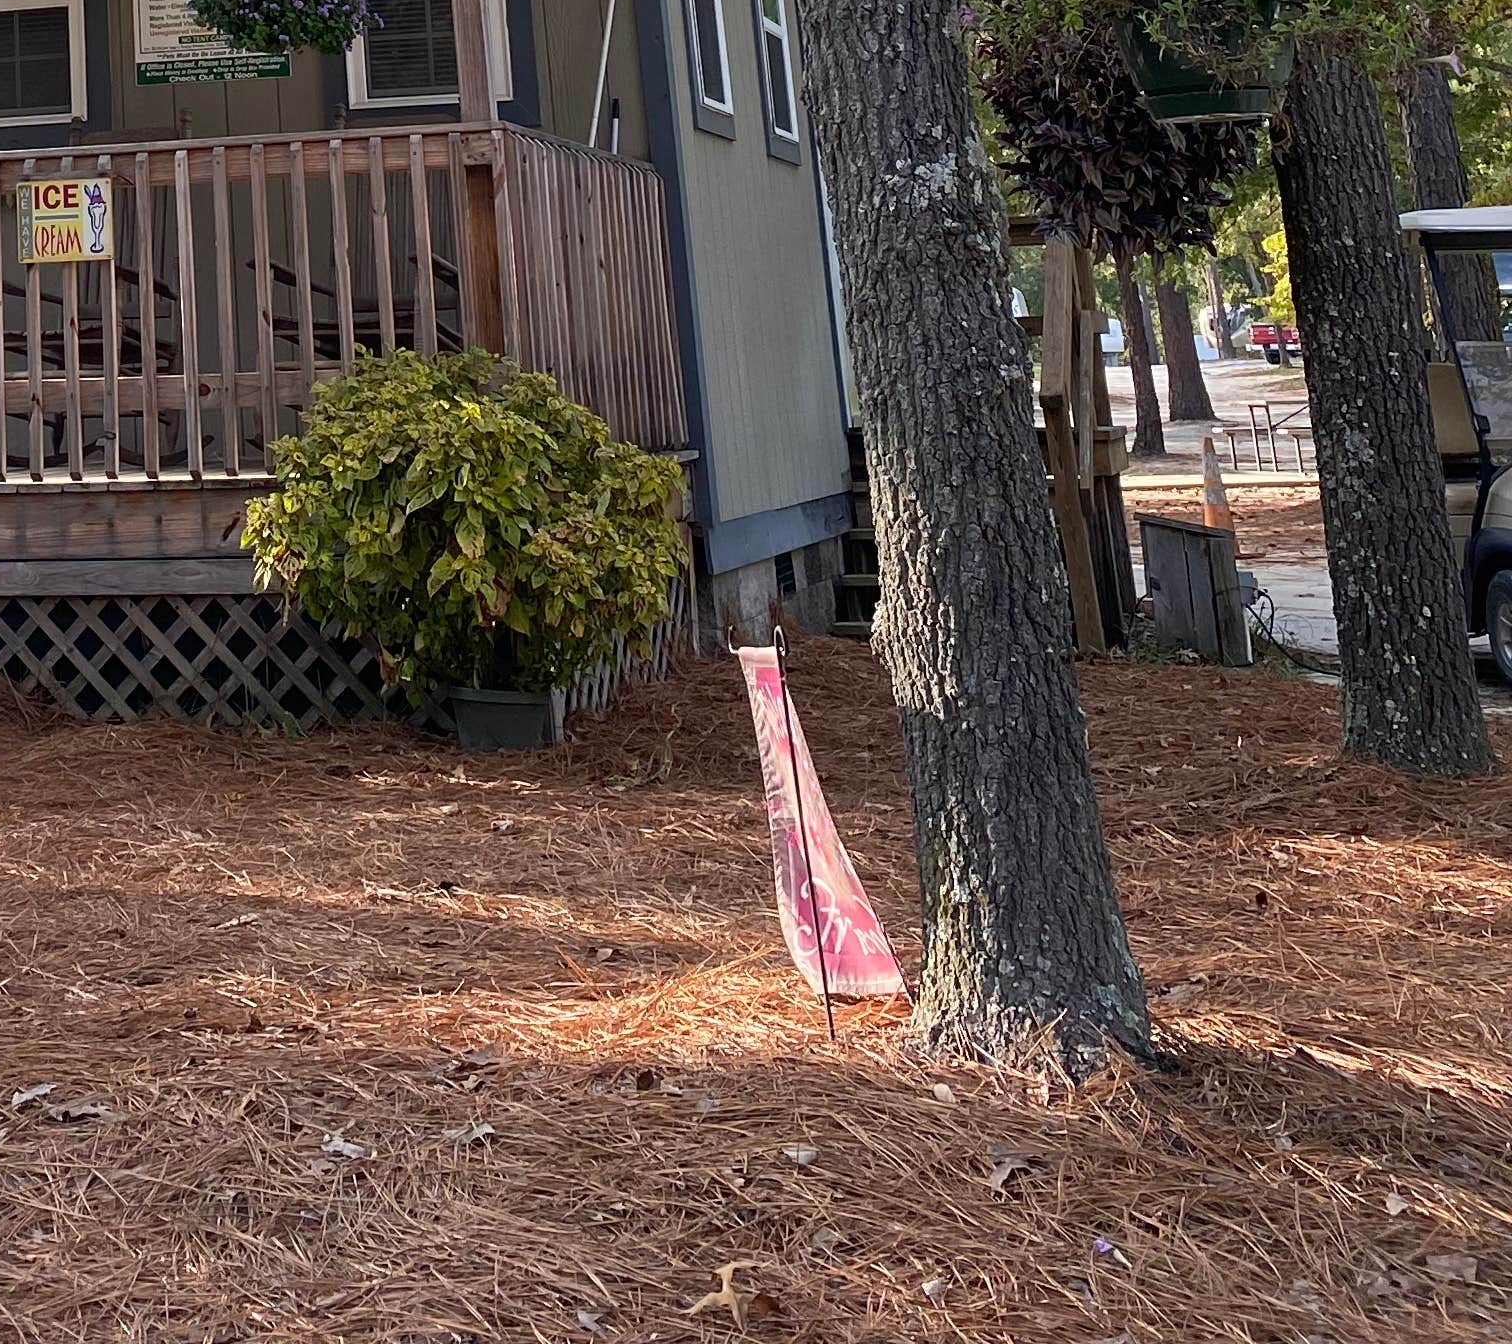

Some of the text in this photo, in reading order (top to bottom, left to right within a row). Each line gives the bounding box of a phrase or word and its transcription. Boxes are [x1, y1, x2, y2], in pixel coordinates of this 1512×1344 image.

[169, 75, 196, 83] Check
[34, 184, 79, 210] ICE
[20, 186, 30, 258] WE HAVE
[34, 224, 82, 257] CREAM
